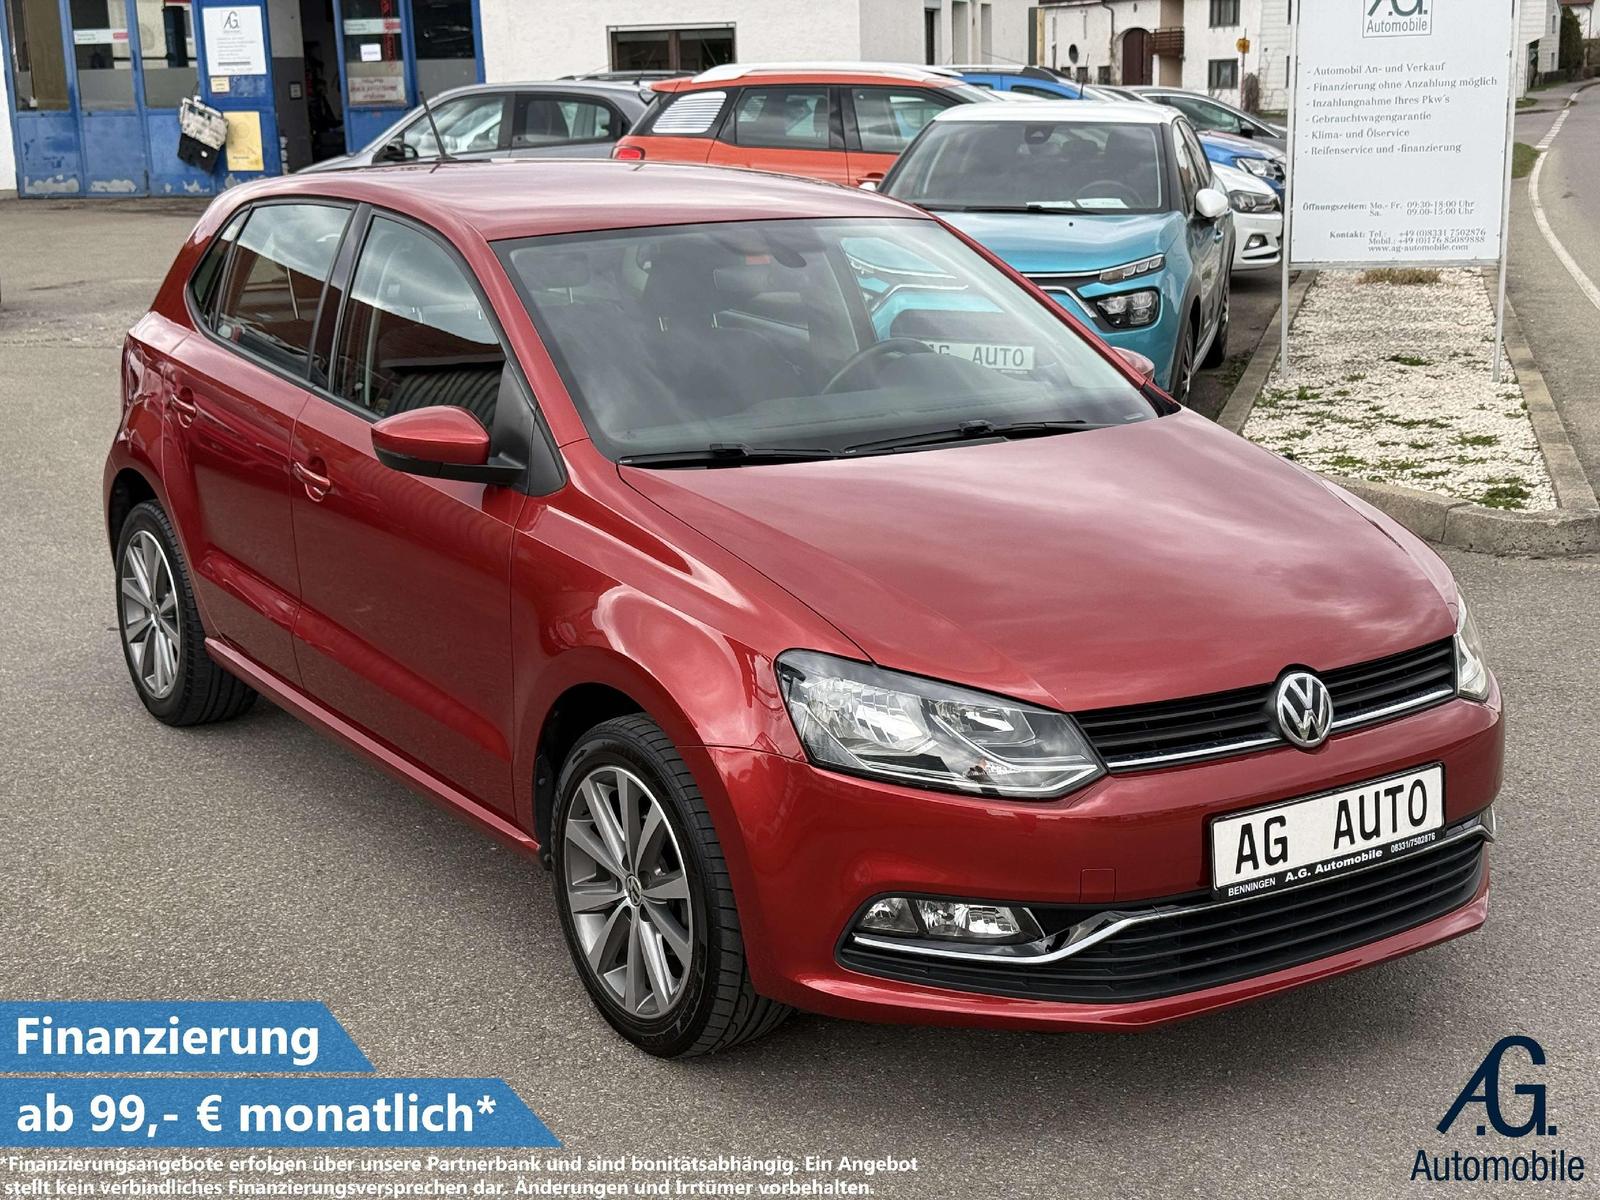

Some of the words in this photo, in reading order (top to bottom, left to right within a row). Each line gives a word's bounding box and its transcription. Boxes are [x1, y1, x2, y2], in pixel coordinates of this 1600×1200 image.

[1366, 17, 1428, 33] Automobile
[1313, 65, 1362, 76] Automobil
[1365, 65, 1382, 74] An-
[1385, 63, 1403, 73] und
[1406, 62, 1446, 72] Verkauf
[1313, 81, 1376, 92] Finanzierung
[1378, 80, 1402, 89] ohne
[1405, 78, 1457, 89] Anzahlung
[1459, 76, 1497, 89] möglich
[1312, 96, 1391, 108] Inzahlungnahme
[1394, 96, 1420, 105] Ihres
[1311, 111, 1432, 124] Gebrauchtwagengarantie
[1311, 130, 1343, 140] Klima-
[1345, 129, 1364, 139] und
[1366, 127, 1410, 138] Ölservice
[1311, 145, 1373, 156] Reifenservice
[1376, 144, 1394, 153] und
[1397, 143, 1462, 154] -finanzierung
[1458, 200, 1475, 208] Uhr
[1458, 207, 1475, 215] Uhr
[1329, 230, 1366, 239] Kontakt:
[972, 346, 1024, 367] AUTO
[1234, 814, 1289, 876] AG
[1333, 778, 1428, 850] AUTO
[1227, 876, 1276, 897] BENNINGEN
[1284, 866, 1312, 883] A.G.
[1314, 848, 1383, 876] Automobile
[1390, 831, 1436, 854] 08331/7502876
